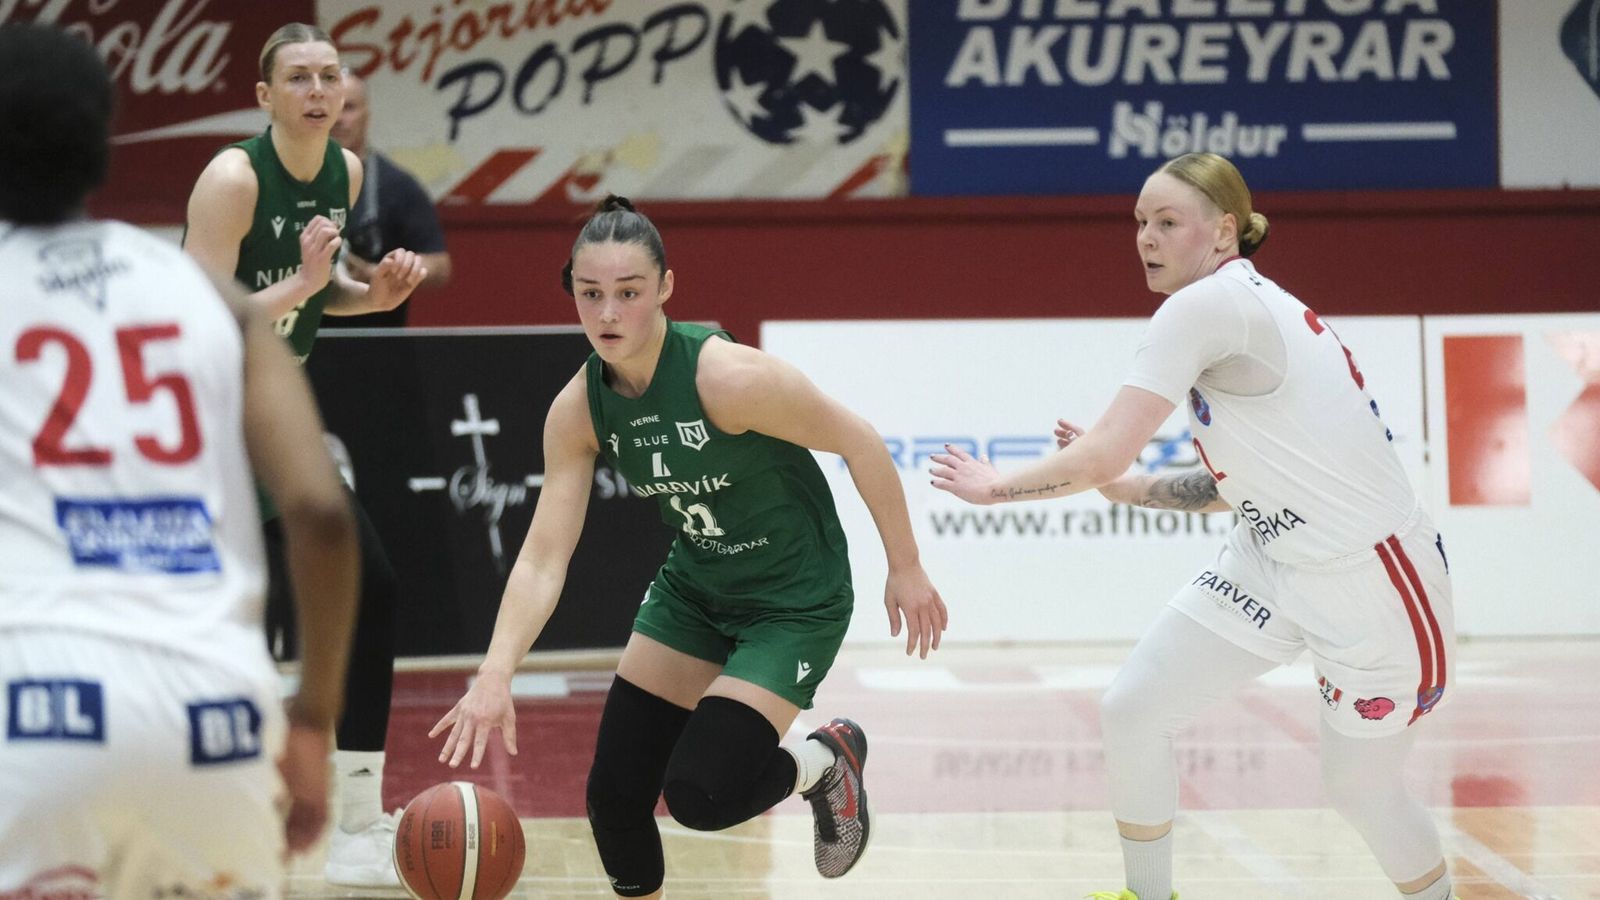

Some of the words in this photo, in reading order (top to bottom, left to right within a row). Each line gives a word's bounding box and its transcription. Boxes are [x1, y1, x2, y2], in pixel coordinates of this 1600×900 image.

[437, 3, 710, 141] POPP
[944, 20, 1455, 87] AKUREYRAR
[1108, 101, 1287, 158] Höldur
[14, 324, 204, 467] 25
[629, 414, 661, 428] VERNE
[1192, 571, 1272, 630] FARVER
[18, 687, 96, 735] BL
